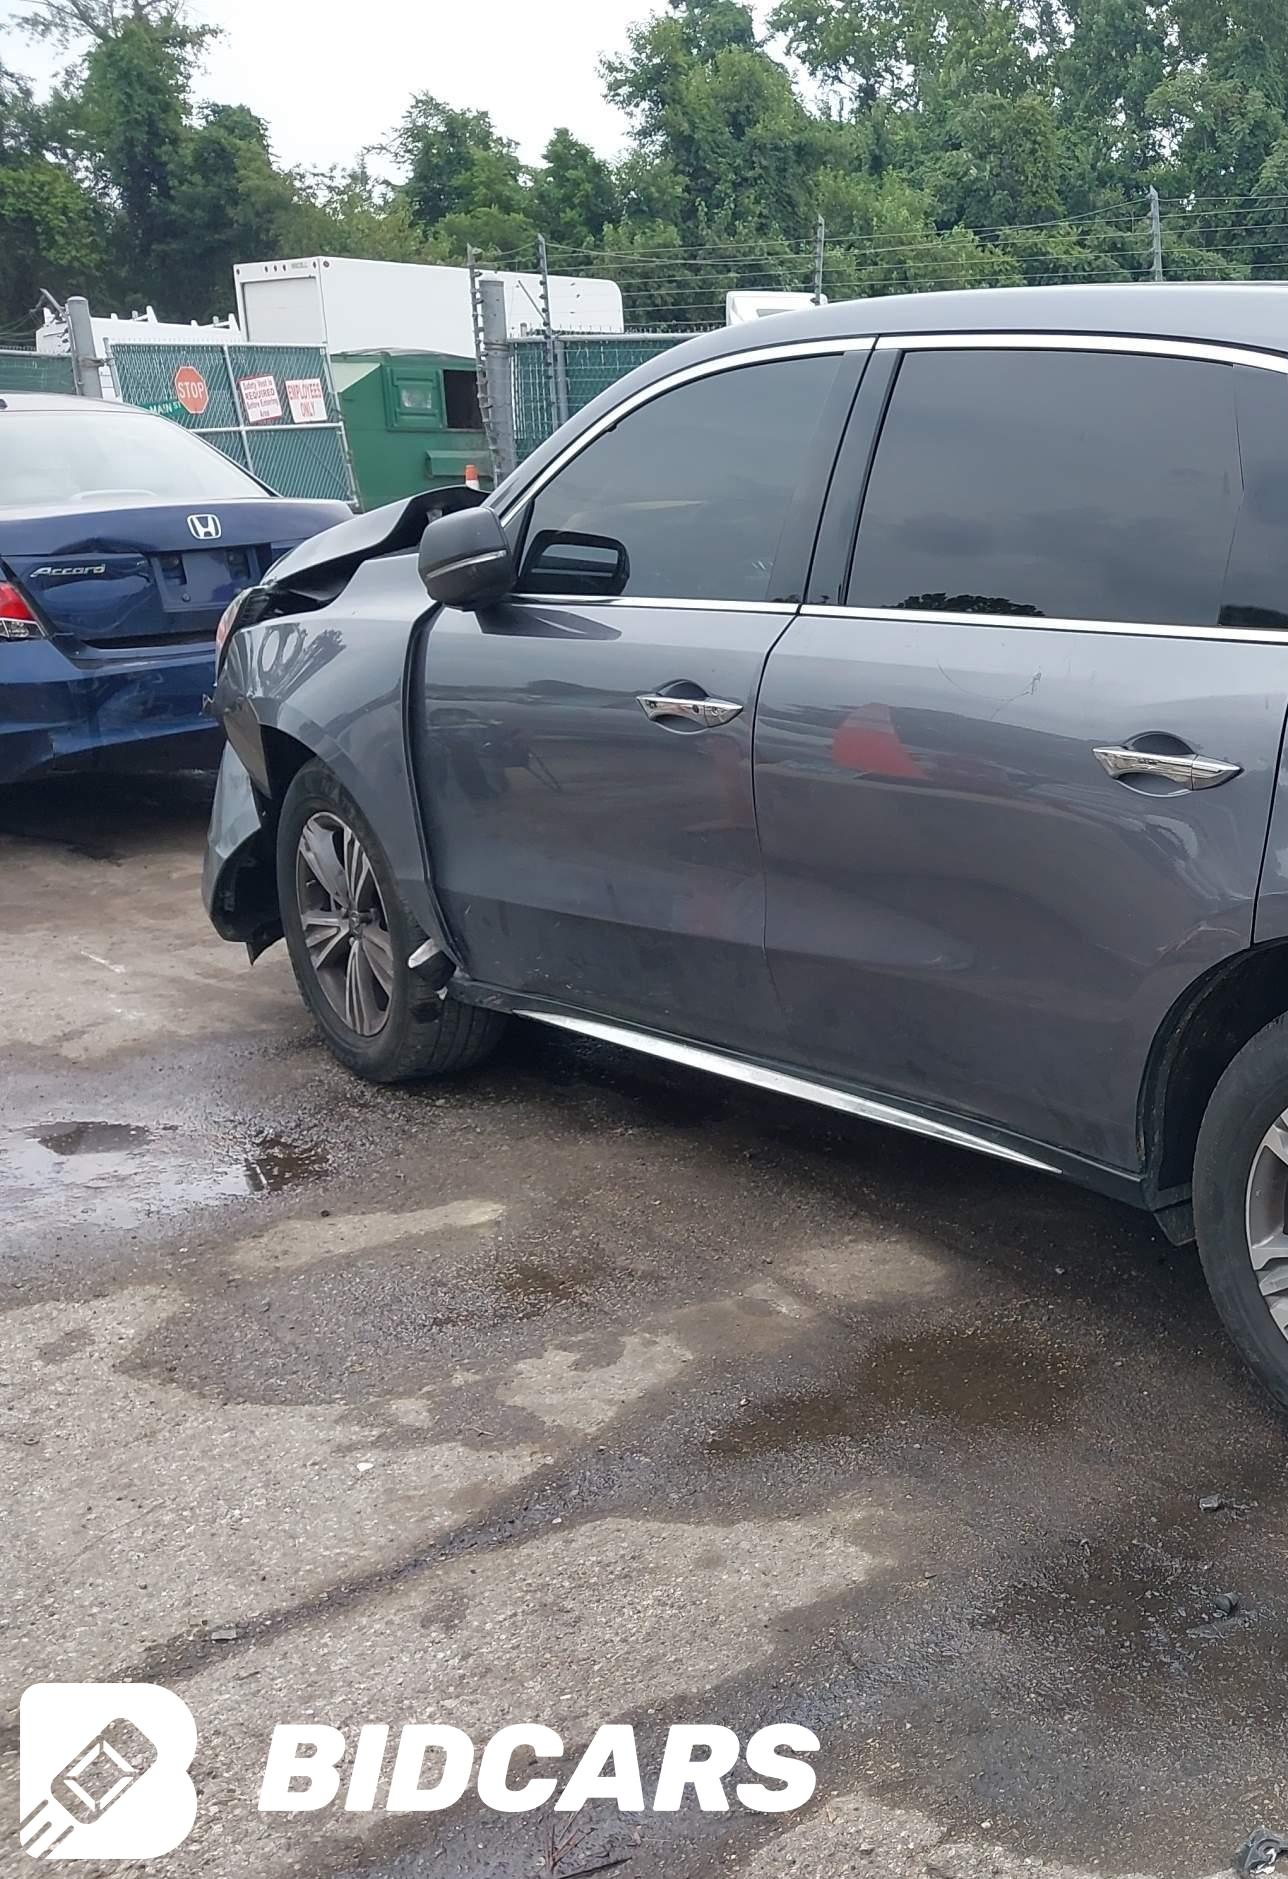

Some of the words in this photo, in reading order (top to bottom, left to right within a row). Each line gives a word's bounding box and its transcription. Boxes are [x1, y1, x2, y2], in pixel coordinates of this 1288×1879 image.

[178, 382, 204, 399] STOP
[245, 388, 276, 400] REQUIRED
[288, 383, 321, 400] EMPLOYEES
[149, 402, 173, 415] MAIN
[300, 401, 316, 417] ONLY
[30, 563, 106, 577] Accord
